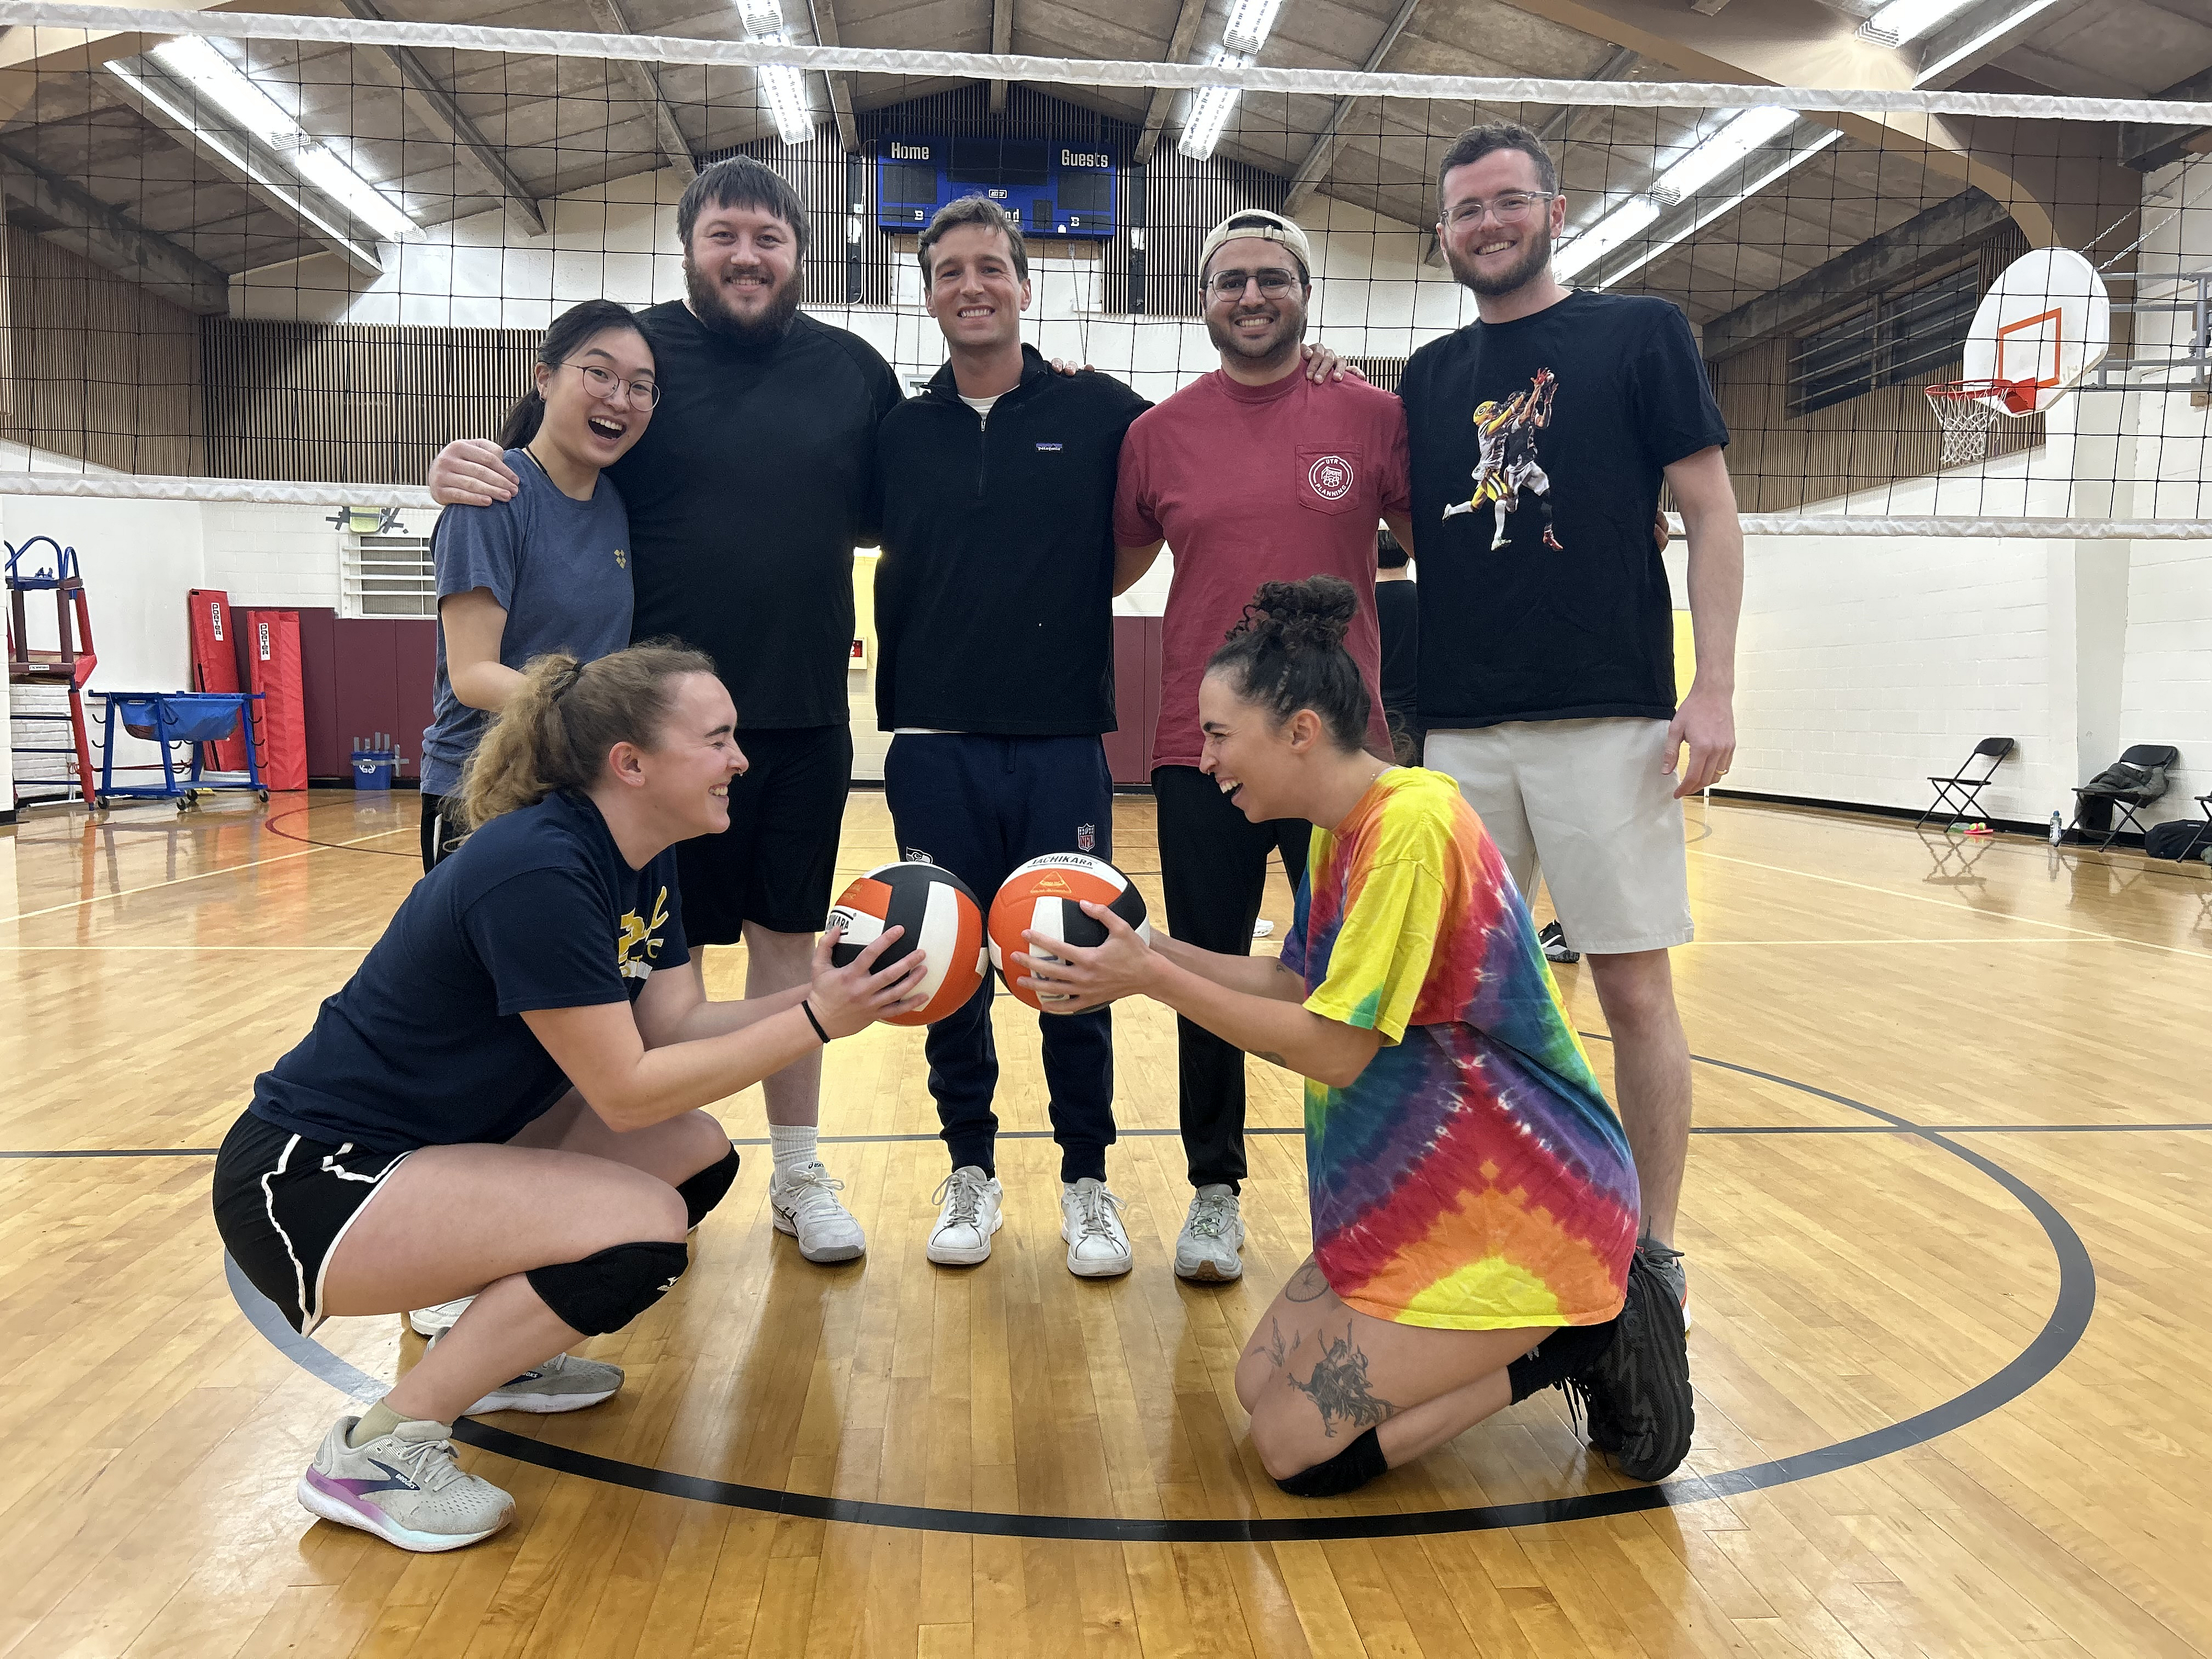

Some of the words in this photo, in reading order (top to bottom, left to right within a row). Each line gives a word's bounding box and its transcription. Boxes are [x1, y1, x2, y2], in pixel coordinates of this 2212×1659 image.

[891, 142, 929, 160] Home
[1062, 149, 1108, 168] Guests
[1315, 483, 1346, 496] PLANNING
[212, 603, 221, 635] PORTER
[1080, 835, 1093, 849] NFL
[395, 1473, 417, 1489] BROOKS
